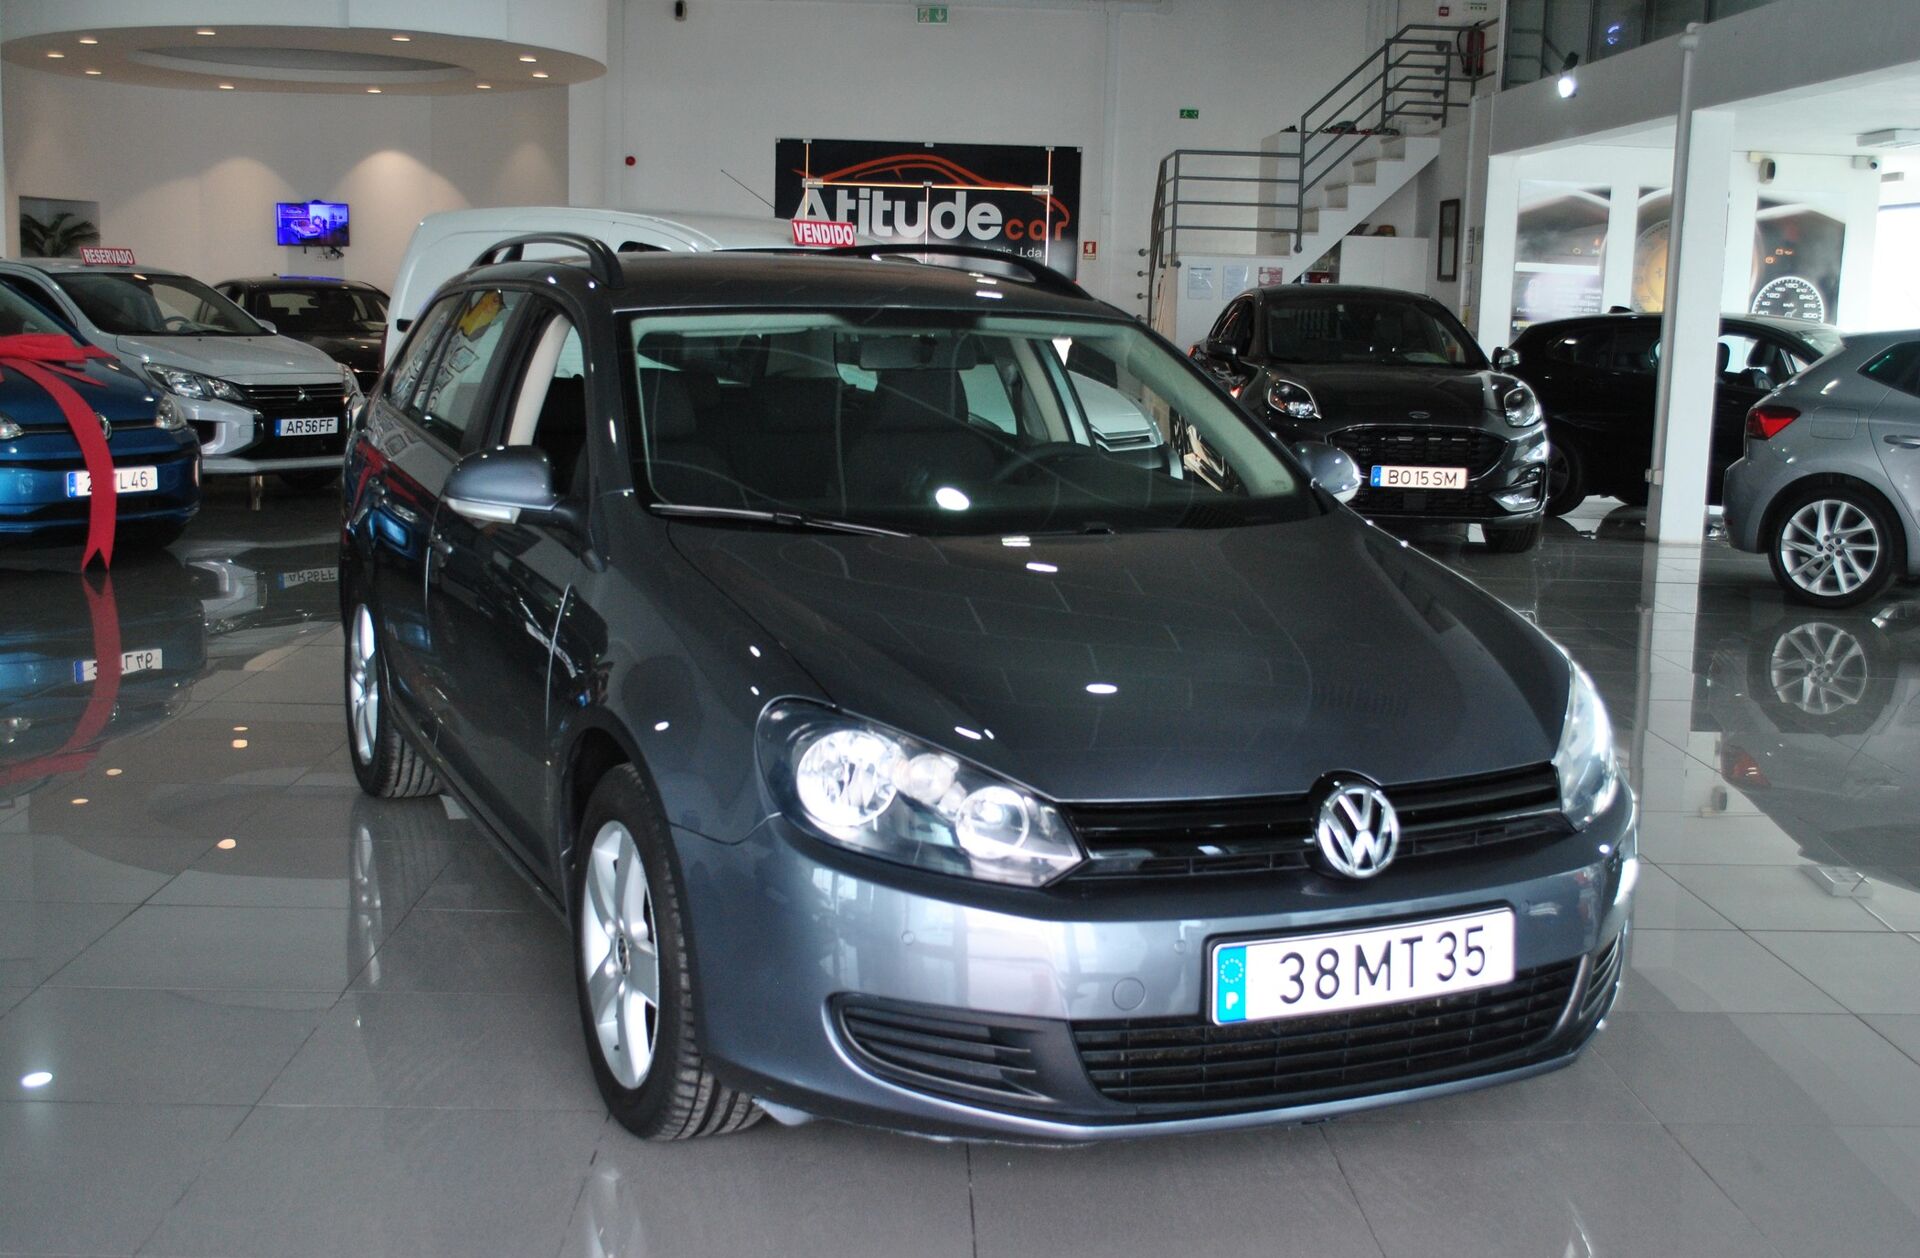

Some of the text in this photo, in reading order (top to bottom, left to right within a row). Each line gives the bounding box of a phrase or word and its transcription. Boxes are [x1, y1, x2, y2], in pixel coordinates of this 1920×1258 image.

[793, 222, 854, 246] VENDIDO
[83, 249, 133, 264] RESERVADO
[1225, 991, 1240, 1010] P
